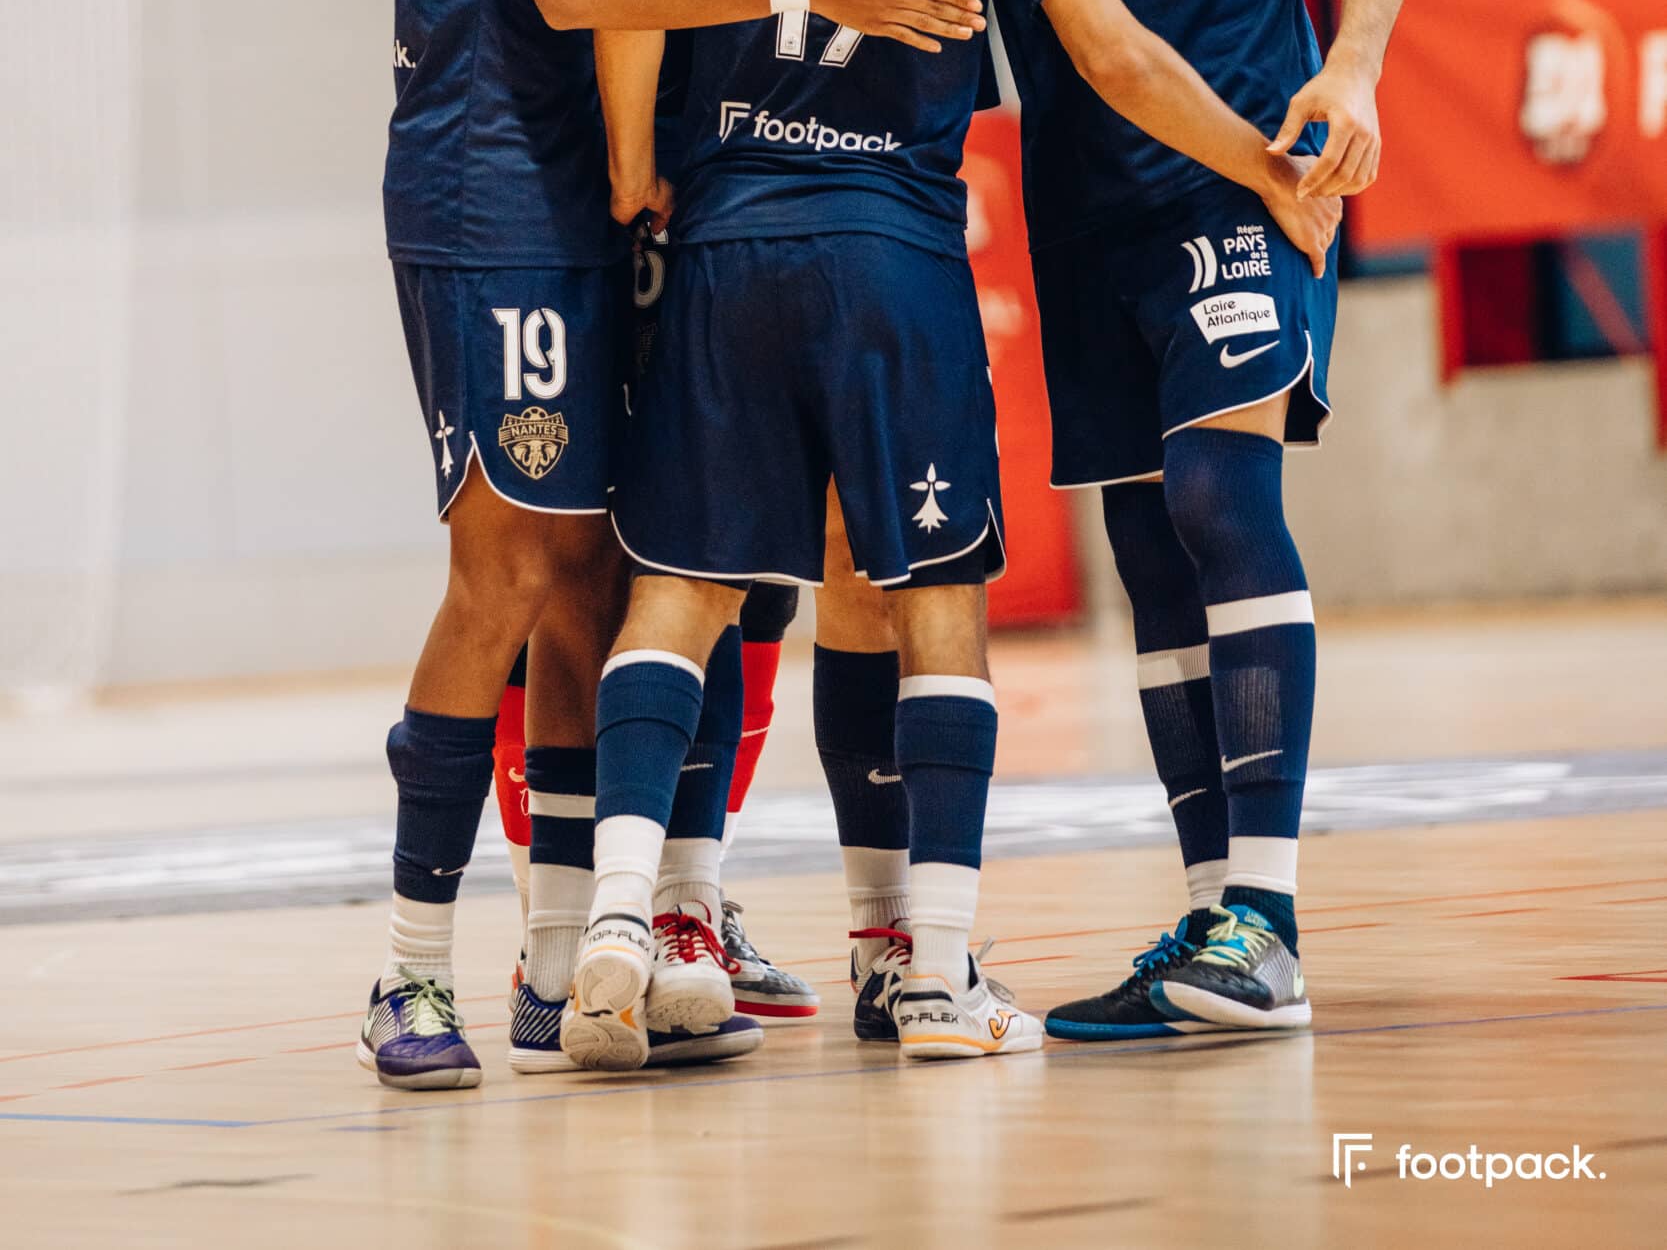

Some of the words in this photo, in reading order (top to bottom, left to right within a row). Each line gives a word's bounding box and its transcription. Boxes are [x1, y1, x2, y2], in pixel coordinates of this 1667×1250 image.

[753, 110, 902, 152] footpack
[1236, 225, 1264, 235] Région
[1223, 234, 1267, 254] PAYS
[1221, 259, 1272, 280] LOIRE
[1203, 300, 1236, 315] Loire
[1207, 309, 1271, 328] Atlantique
[491, 308, 567, 400] 19
[511, 424, 558, 437] NANTES
[899, 1011, 959, 1026] OP-FLEX
